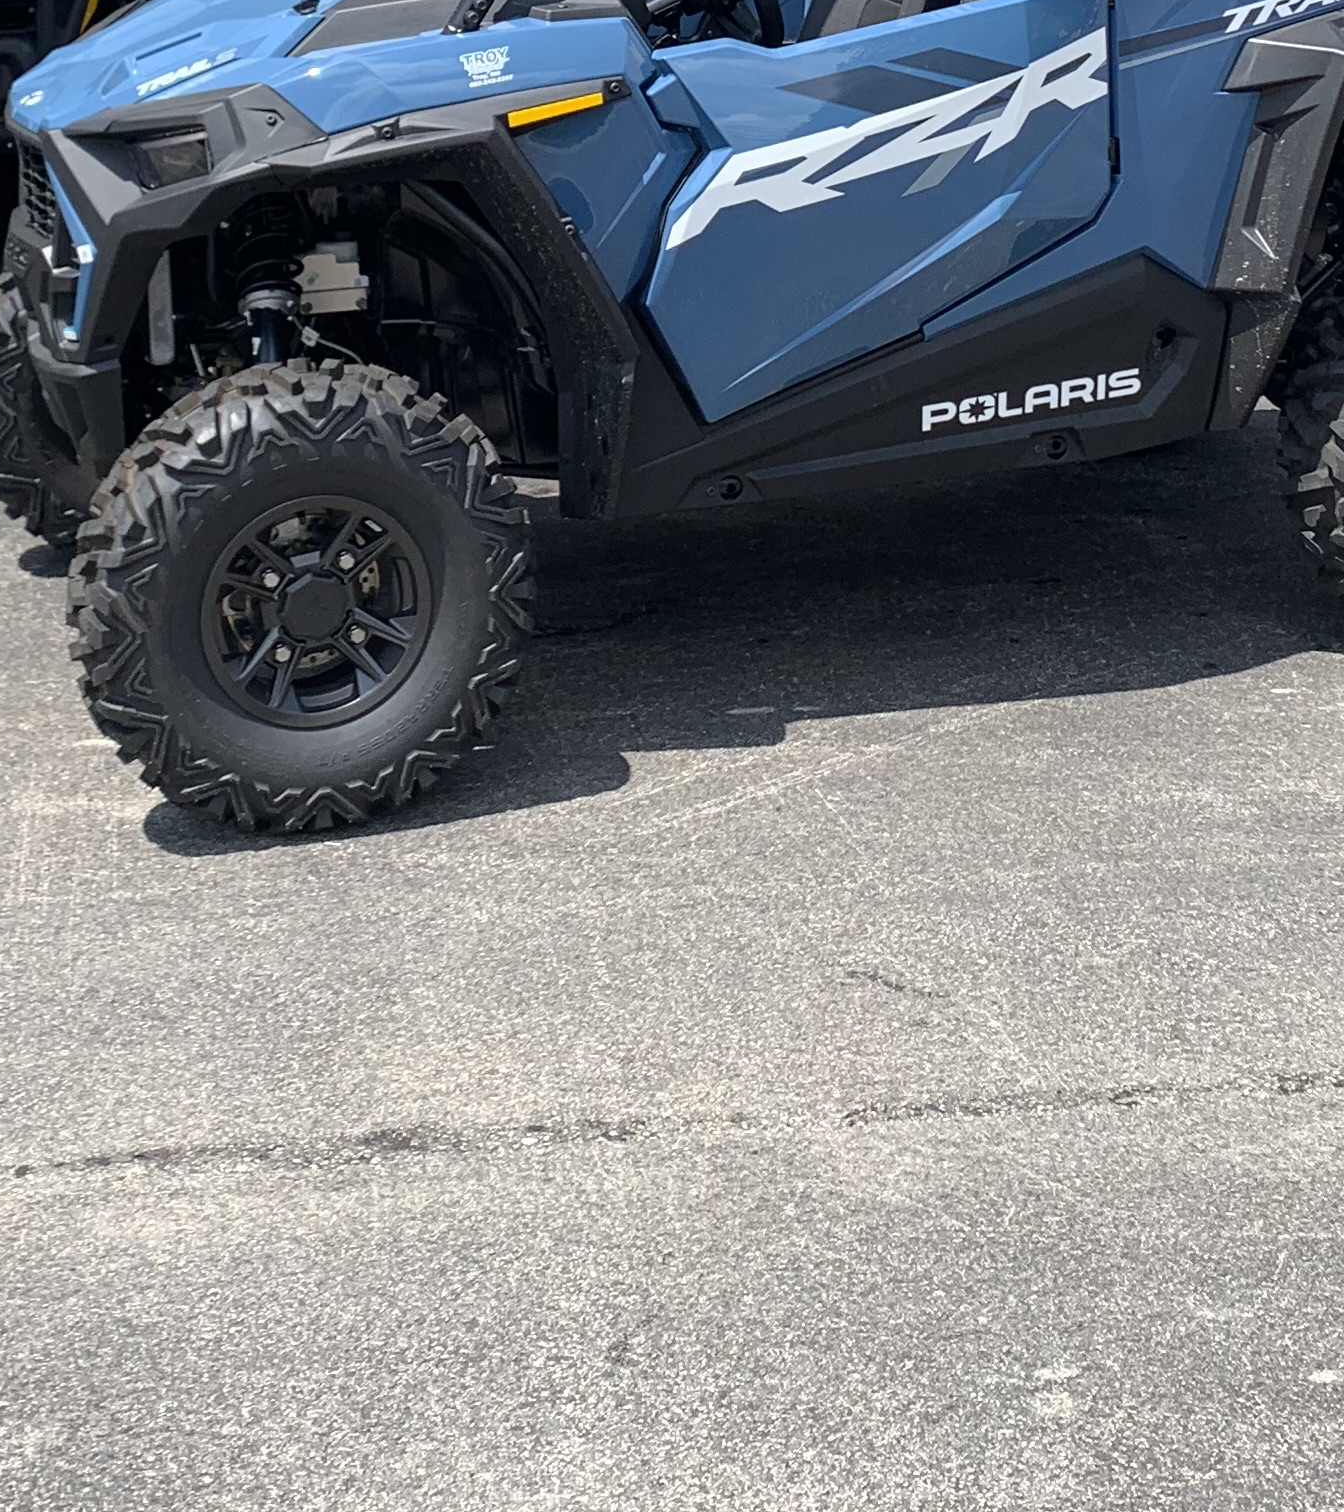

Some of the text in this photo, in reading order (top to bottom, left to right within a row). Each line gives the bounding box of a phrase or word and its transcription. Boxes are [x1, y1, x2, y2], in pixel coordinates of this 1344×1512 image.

[136, 58, 212, 96] TRAIL
[462, 48, 507, 65] TROY
[665, 26, 1108, 250] RZR
[921, 367, 1142, 432] POLARIS
